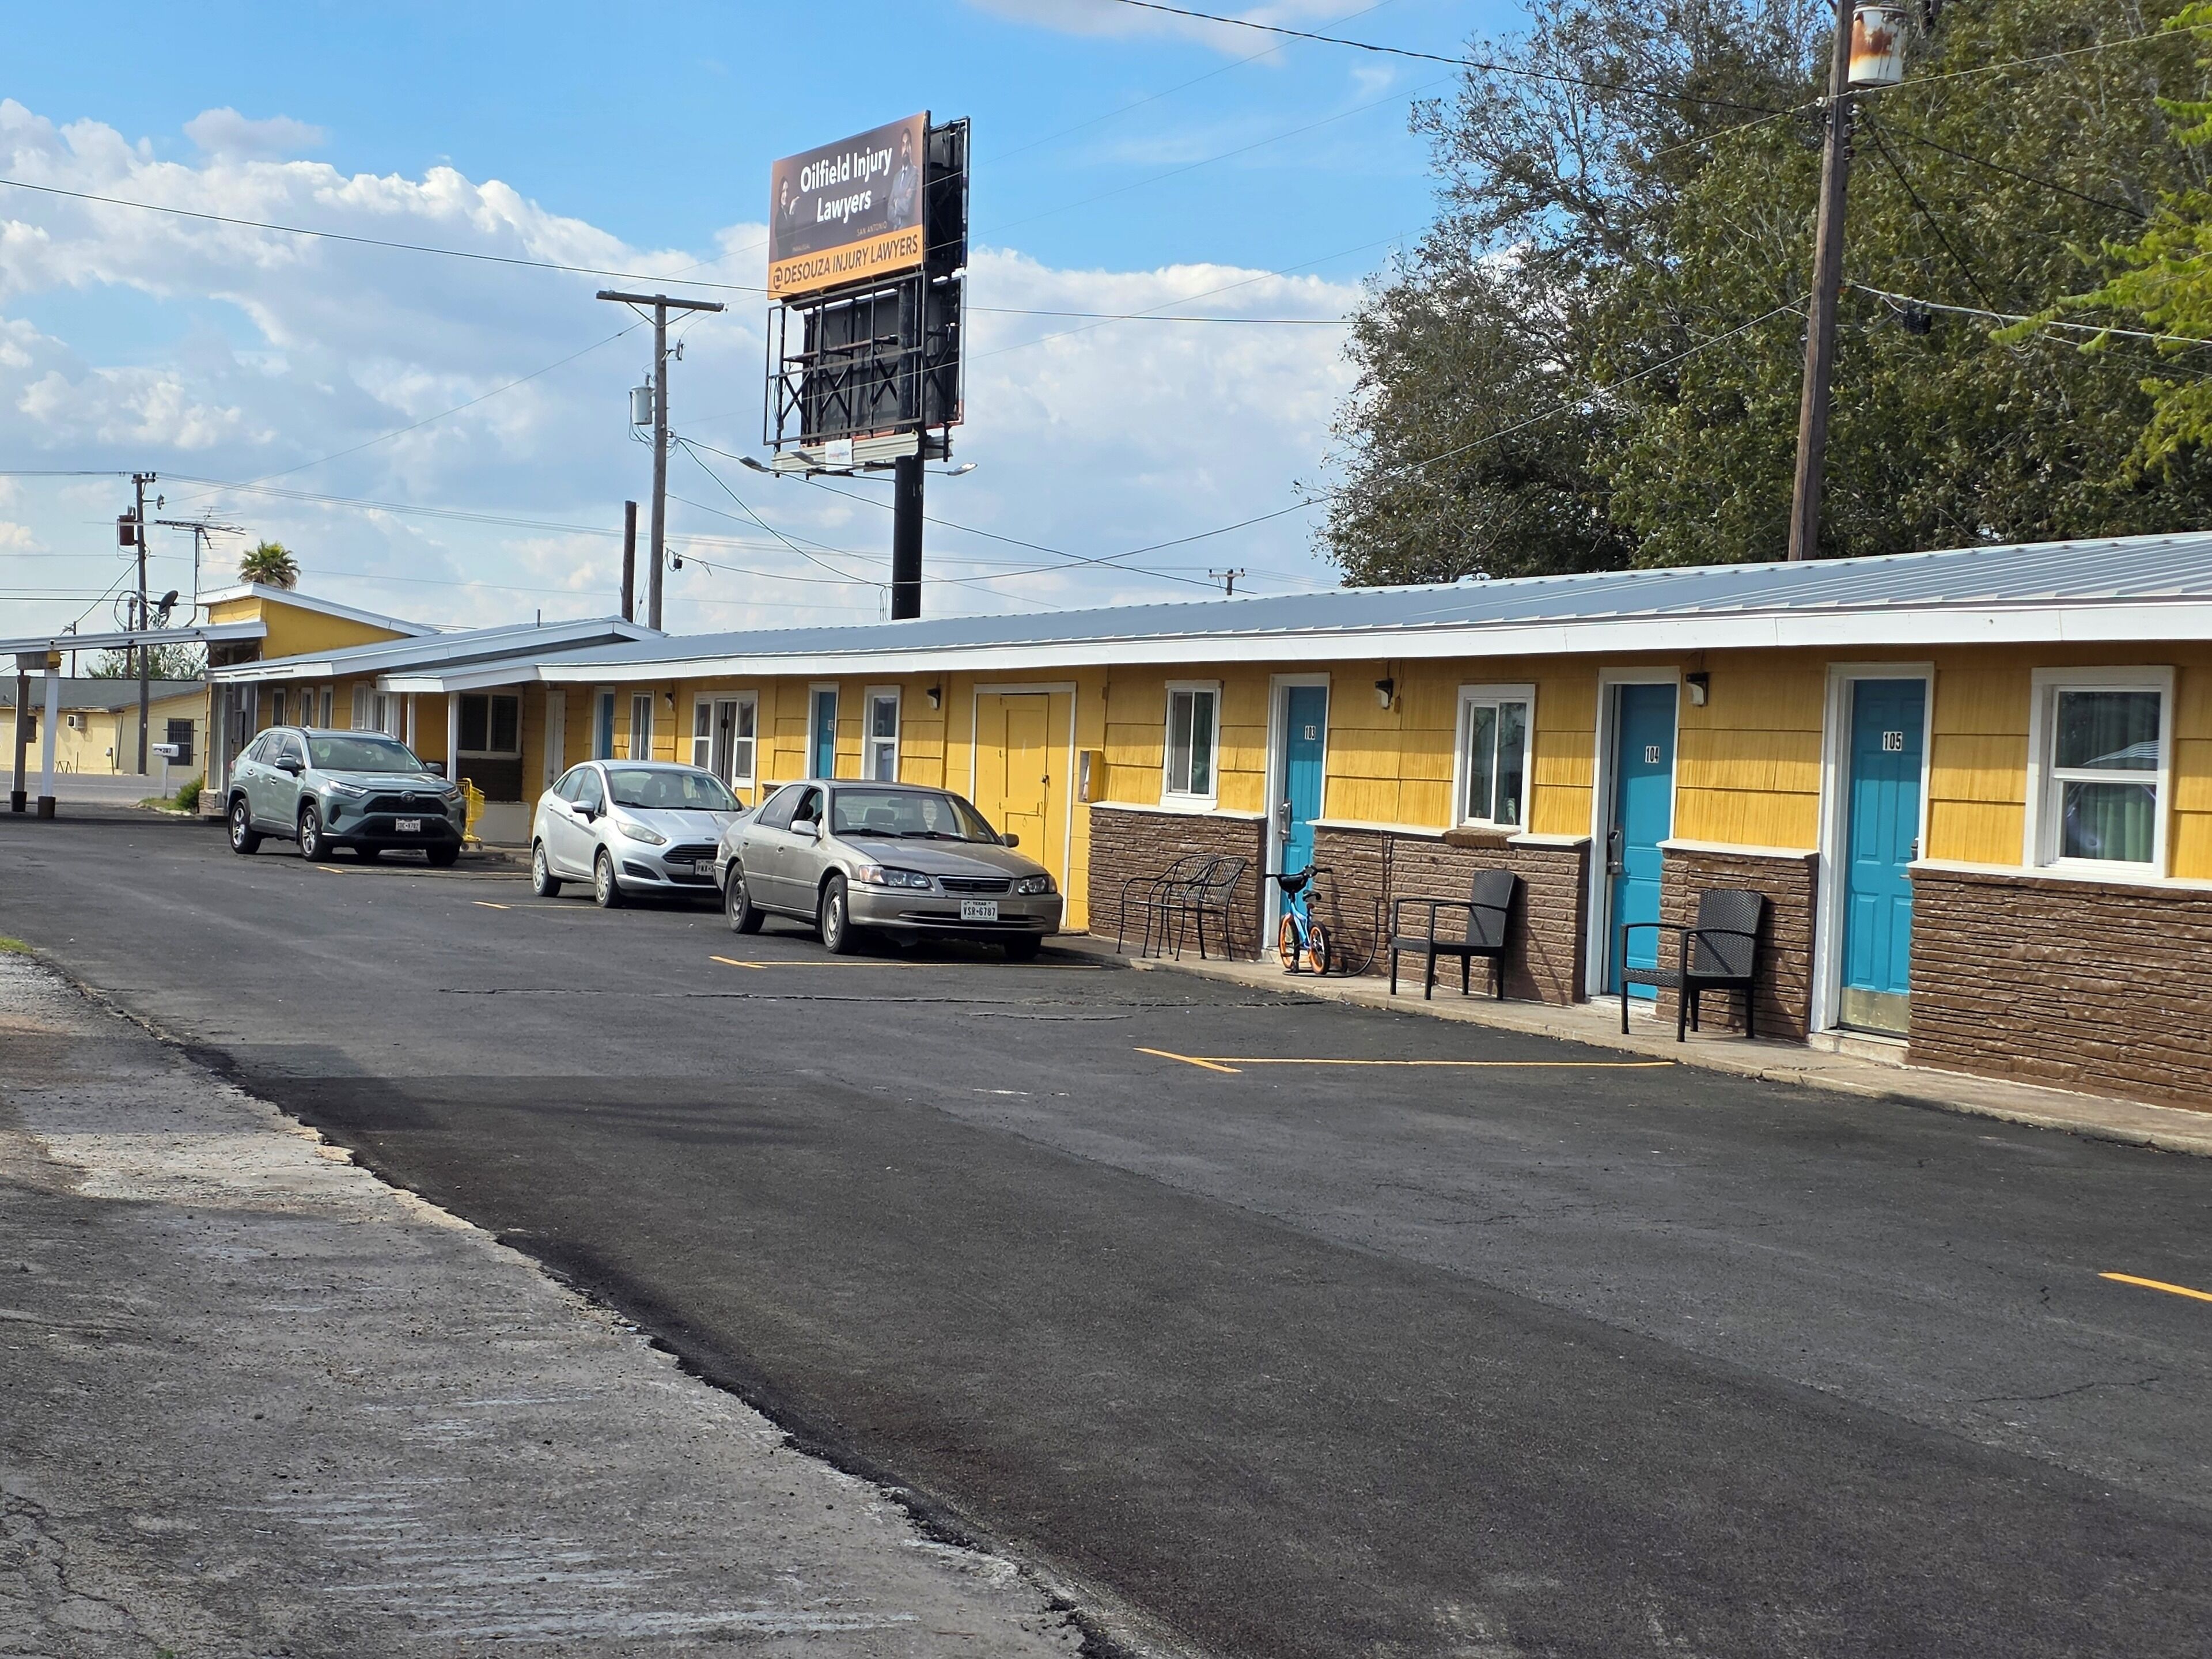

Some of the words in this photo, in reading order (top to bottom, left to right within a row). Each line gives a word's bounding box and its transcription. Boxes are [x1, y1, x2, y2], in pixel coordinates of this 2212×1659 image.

[800, 153, 850, 192] Oilfield
[854, 147, 892, 183] Injury
[817, 190, 872, 224] Lawyers
[783, 257, 830, 285] DESOUZA
[832, 247, 869, 273] INJURY
[870, 234, 918, 263] LAWYERS
[1305, 726, 1315, 739] 103
[1884, 732, 1902, 750] 105
[1646, 747, 1658, 762] 104
